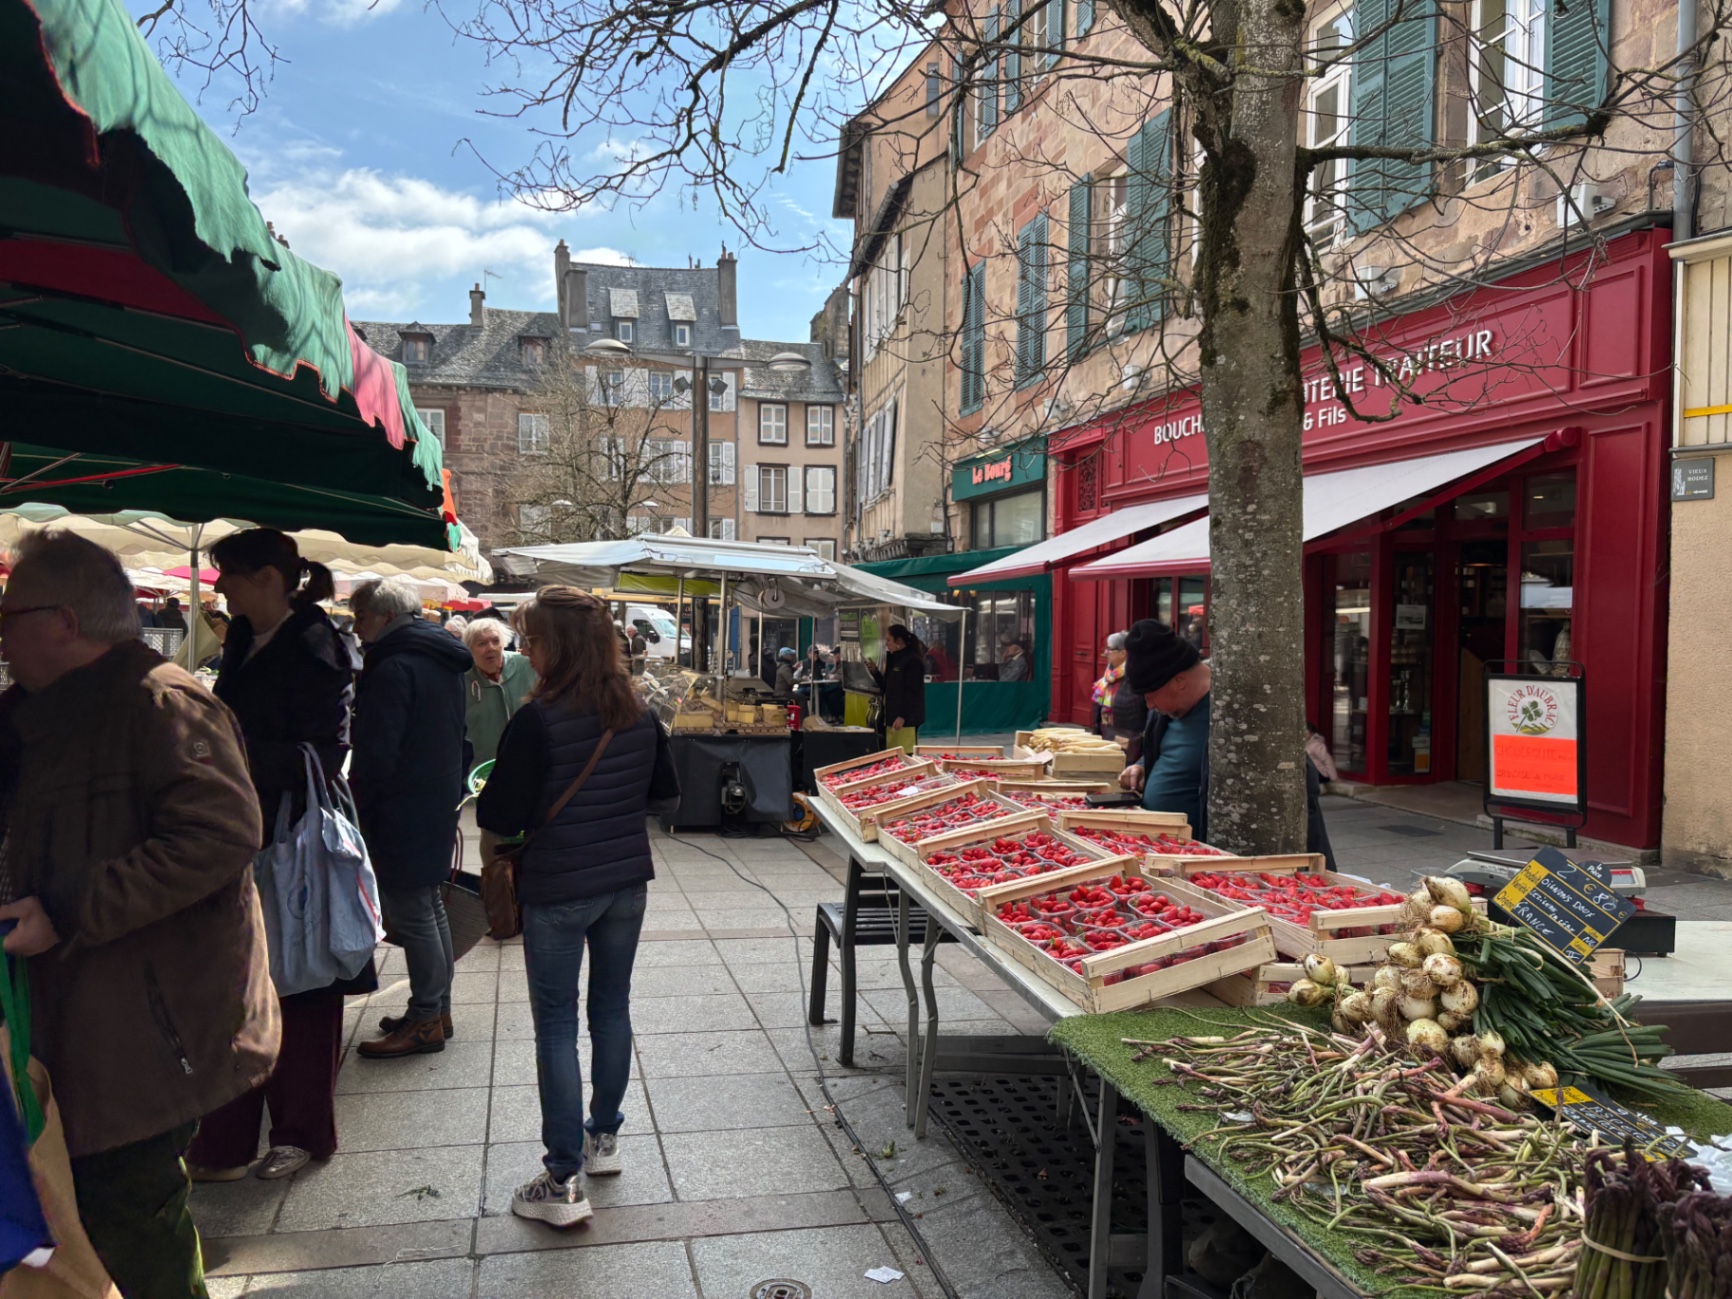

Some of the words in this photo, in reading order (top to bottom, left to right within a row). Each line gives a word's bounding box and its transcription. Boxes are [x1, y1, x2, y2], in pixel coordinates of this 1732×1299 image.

[1153, 413, 1205, 445] BOUCH
[1318, 405, 1347, 428] Fils
[972, 466, 983, 485] Le
[984, 454, 1012, 482] Bourg
[1507, 689, 1526, 721] FLEUR
[1525, 685, 1558, 726] D'AUBRAC
[1511, 877, 1528, 894] Variété
[1520, 865, 1542, 885] Produit
[1556, 863, 1577, 879] 2
[1592, 892, 1617, 911] 80
[1496, 891, 1515, 909] Origine
[1514, 901, 1555, 935] FRANCE
